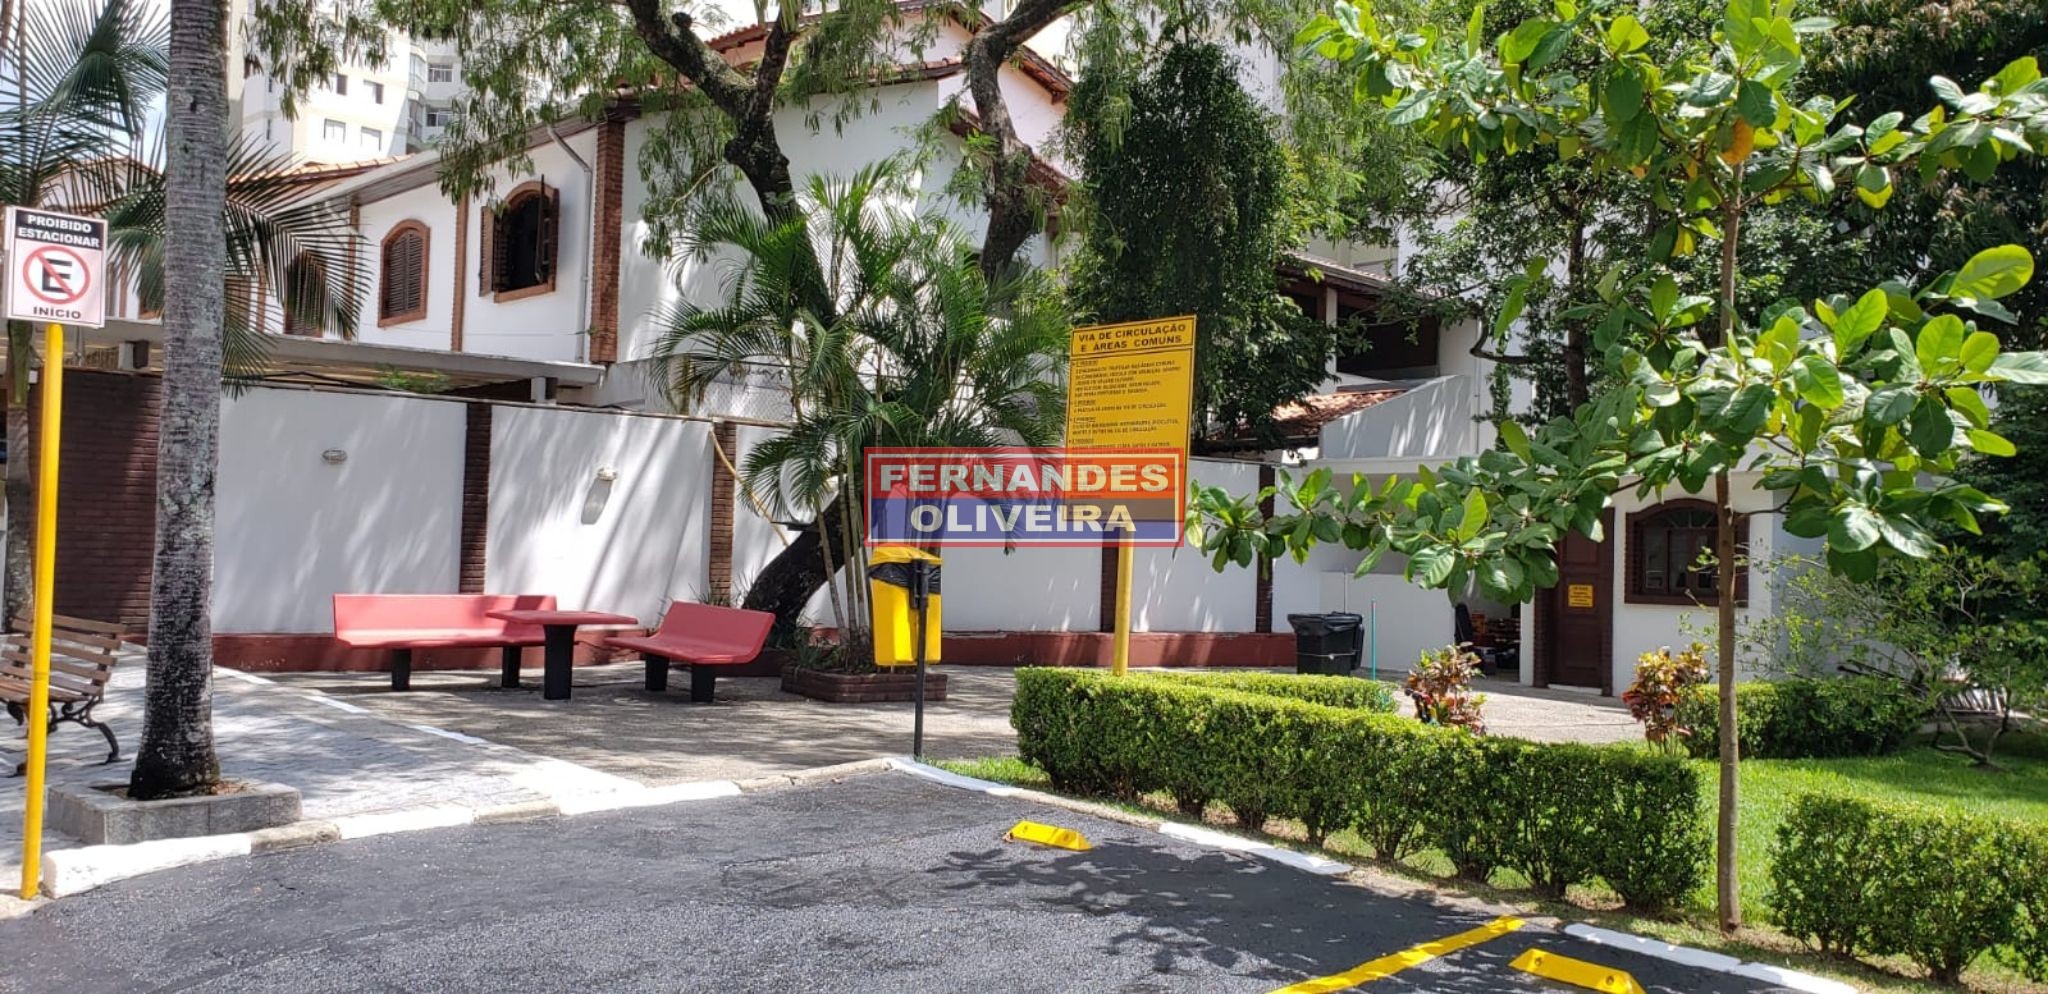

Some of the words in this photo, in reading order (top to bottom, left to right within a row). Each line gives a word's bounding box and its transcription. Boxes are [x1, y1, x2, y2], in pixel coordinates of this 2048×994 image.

[27, 214, 92, 233] PROIBIDO
[18, 227, 100, 247] ESTACIONAR
[41, 258, 73, 293] E
[1079, 334, 1095, 342] VIA
[1099, 330, 1113, 339] DE
[1116, 324, 1186, 338] CIRCULAÇÃO
[1081, 344, 1087, 352] E
[1134, 335, 1182, 347] COMUNS
